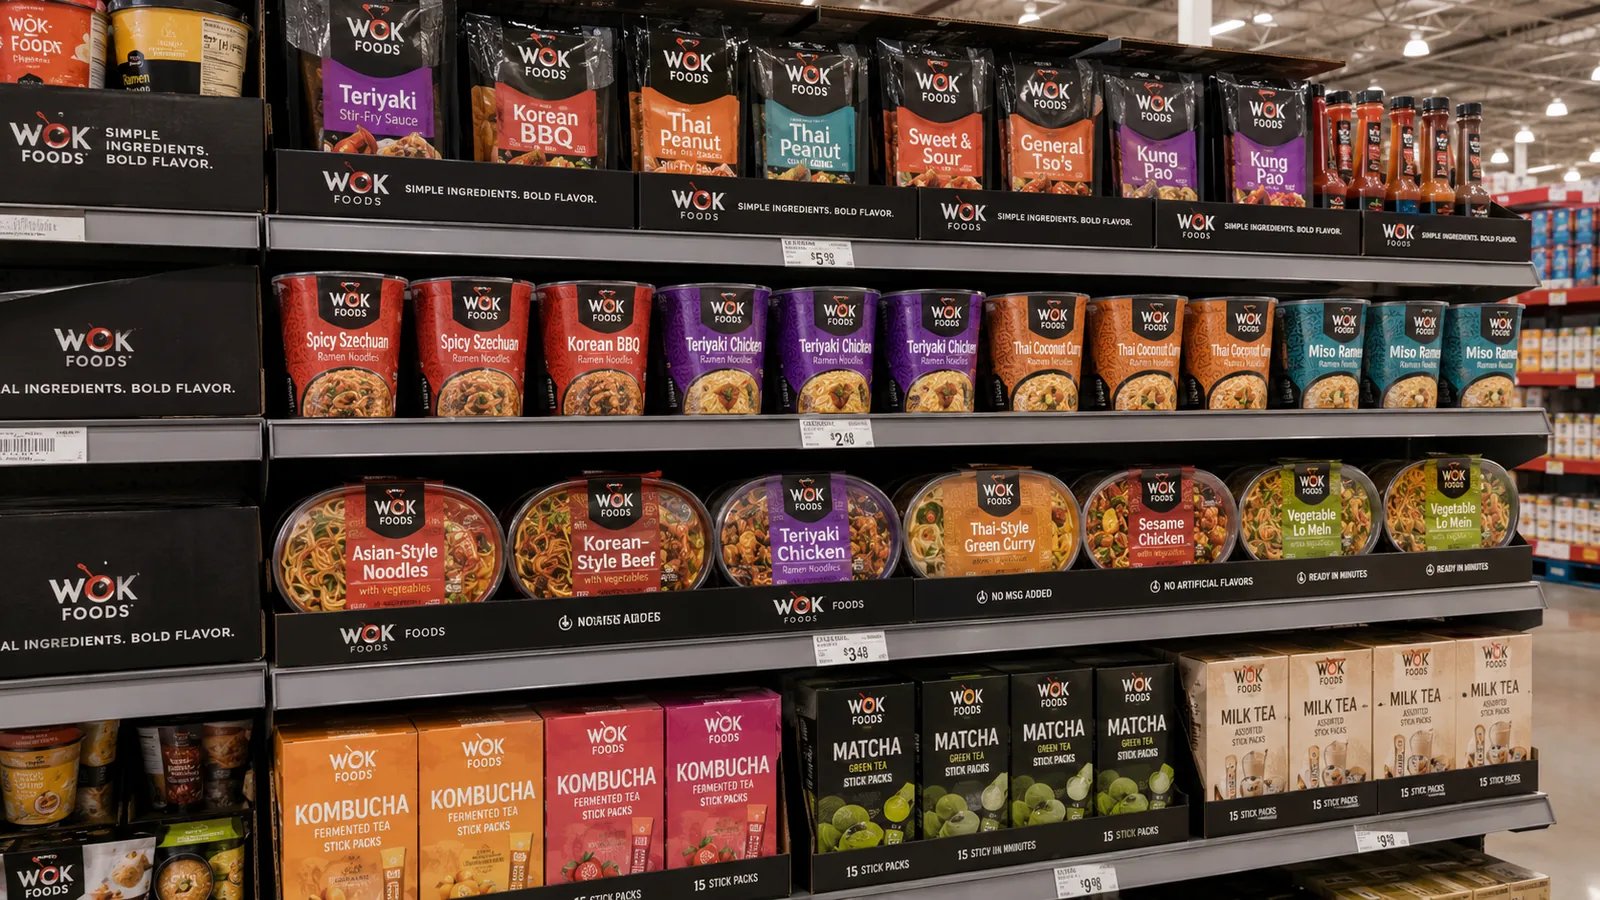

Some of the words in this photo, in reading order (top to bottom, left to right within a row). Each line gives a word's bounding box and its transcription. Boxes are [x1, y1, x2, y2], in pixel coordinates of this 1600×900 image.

[346, 17, 404, 42] WOK
[355, 40, 400, 56] FOODS
[518, 45, 571, 69] WOK
[663, 50, 713, 73] WOK
[525, 66, 566, 80] FOODS
[670, 71, 709, 84] FOODS
[916, 72, 959, 93] WOK
[339, 84, 416, 110] Teriyaki
[922, 92, 956, 104] FOODS
[340, 109, 382, 125] Stir-Fry
[385, 113, 418, 126] Sauce
[514, 104, 578, 126] Korean
[667, 112, 711, 135] Thai
[9, 122, 91, 149] WOK
[106, 128, 160, 140] SIMPLE
[521, 124, 573, 149] BBQ
[660, 130, 721, 151] Peanut
[789, 123, 830, 144] Thai
[909, 129, 956, 149] Sweet
[961, 134, 972, 149] &
[106, 141, 209, 156] INGREDIENTS.
[780, 139, 841, 161] Peanut
[1021, 135, 1083, 155] General
[22, 150, 85, 164] FOODS
[106, 155, 147, 165] BOLD
[152, 158, 213, 169] FLAVOR.
[923, 148, 962, 167] Sour
[1032, 153, 1072, 171] Tso's
[1137, 146, 1178, 167] Kung
[1250, 152, 1288, 173] Kung
[1144, 163, 1172, 181] Pao
[1257, 169, 1283, 185] Pao
[322, 170, 390, 195] WOK
[334, 194, 381, 206] FOODS
[405, 185, 444, 195] SIMPLE
[447, 187, 520, 199] INGREDIENTS.
[523, 192, 551, 200] BOLD
[554, 193, 597, 203] FLAVOR.
[671, 189, 725, 211] WOK
[681, 210, 718, 221] FOODS
[738, 203, 769, 212] SIMPLE
[772, 204, 832, 215] INGREDIENTS.
[834, 207, 856, 216] BOLD
[859, 208, 894, 218] FLAVOR.
[941, 202, 986, 222] WOK
[948, 222, 981, 231] FOODS
[998, 213, 1024, 222] SIMPLE
[1027, 214, 1078, 224] INGREDIENTS.
[1081, 216, 1100, 224] BOLD
[1102, 217, 1132, 226] FLAVOR.
[1177, 213, 1215, 232] WOK
[329, 293, 370, 308] WOK
[334, 308, 367, 318] FOODS
[54, 328, 134, 352] WOK
[307, 332, 337, 350] Spicy
[339, 332, 388, 349] Szechuan
[441, 334, 471, 352] Spicy
[473, 334, 519, 351] Szechuan
[568, 337, 613, 352] Korean
[617, 337, 640, 353] BBQ
[686, 337, 728, 354] Teriyaki
[1014, 341, 1031, 355] Thai
[1033, 342, 1064, 355] Coconut
[318, 352, 346, 361] Ramen
[1309, 345, 1336, 358] Miso
[1466, 346, 1493, 359] Miso
[66, 355, 127, 367] FOODS
[1, 384, 19, 394] AL
[25, 384, 126, 394] INGREDIENTS.
[132, 384, 170, 394] BOLD
[176, 384, 235, 394] FLAVOR.
[374, 500, 416, 515] WOK
[1430, 502, 1475, 517] Vegetable
[380, 516, 412, 525] FOODS
[1139, 518, 1184, 530] Sesame
[1436, 519, 1447, 529] Lo
[1450, 517, 1472, 528] Mein
[780, 526, 839, 545] Teriyaki
[971, 520, 1028, 538] Thai-Style
[584, 536, 649, 551] Korean-
[964, 539, 1000, 552] Green
[1003, 537, 1035, 552] Curry
[1139, 532, 1184, 546] Chicken
[353, 544, 437, 563] Asian-Style
[578, 555, 616, 571] Style
[622, 552, 655, 567] Beef
[778, 545, 845, 562] Chicken
[363, 562, 428, 580] Noodles
[1309, 572, 1330, 581] READY
[1331, 572, 1338, 580] IN
[1340, 570, 1367, 579] MINUTES
[49, 575, 138, 604] WOK
[1164, 582, 1175, 590] NO
[1178, 579, 1218, 589] ARTIFICIAL
[1220, 577, 1253, 586] FLAVORS
[992, 592, 1003, 601] NO
[1006, 590, 1022, 600] MSG
[1025, 589, 1052, 598] ADDED
[62, 605, 130, 621] FOODS
[1, 640, 19, 650] AL
[24, 635, 126, 649] INGREDIENTS.
[131, 632, 170, 643] BOLD
[176, 628, 234, 640] FLAVOR.
[340, 624, 394, 644] WOK
[405, 627, 445, 638] FOODS
[351, 644, 387, 653] FOODS
[1234, 667, 1263, 683] WOK
[1238, 684, 1261, 693] FOODS
[848, 697, 885, 713] WOK
[852, 714, 882, 725] FOODS
[1221, 710, 1250, 725] MILK
[1254, 705, 1276, 722] TEA
[833, 737, 901, 761] MATCHA
[330, 750, 376, 770] WOK
[849, 763, 872, 773] GREEN
[874, 761, 887, 770] TEA
[335, 770, 372, 782] FOODS
[557, 766, 656, 795] KOMBUCHA
[844, 776, 866, 787] STICK
[868, 773, 892, 784] PACKS
[574, 795, 623, 807] FERMENTED
[625, 792, 640, 802] TEA
[295, 794, 409, 826] KOMBUCHA
[582, 808, 605, 820] STICK
[607, 806, 632, 817] PACKS
[1230, 811, 1238, 821] 15
[1241, 809, 1257, 819] STICK
[1258, 807, 1276, 816] PACKS
[315, 823, 370, 838] FERMENTED
[374, 821, 390, 831] TEA
[324, 839, 350, 852] STICK
[353, 837, 381, 849] PACKS
[17, 864, 74, 887] WOK
[846, 866, 858, 877] 15
[861, 863, 883, 874] STICK
[885, 860, 909, 871] PACKS
[694, 880, 705, 891] 15
[709, 877, 731, 888] STICK
[733, 873, 758, 884] PACKS
[25, 884, 69, 898] FOODS
